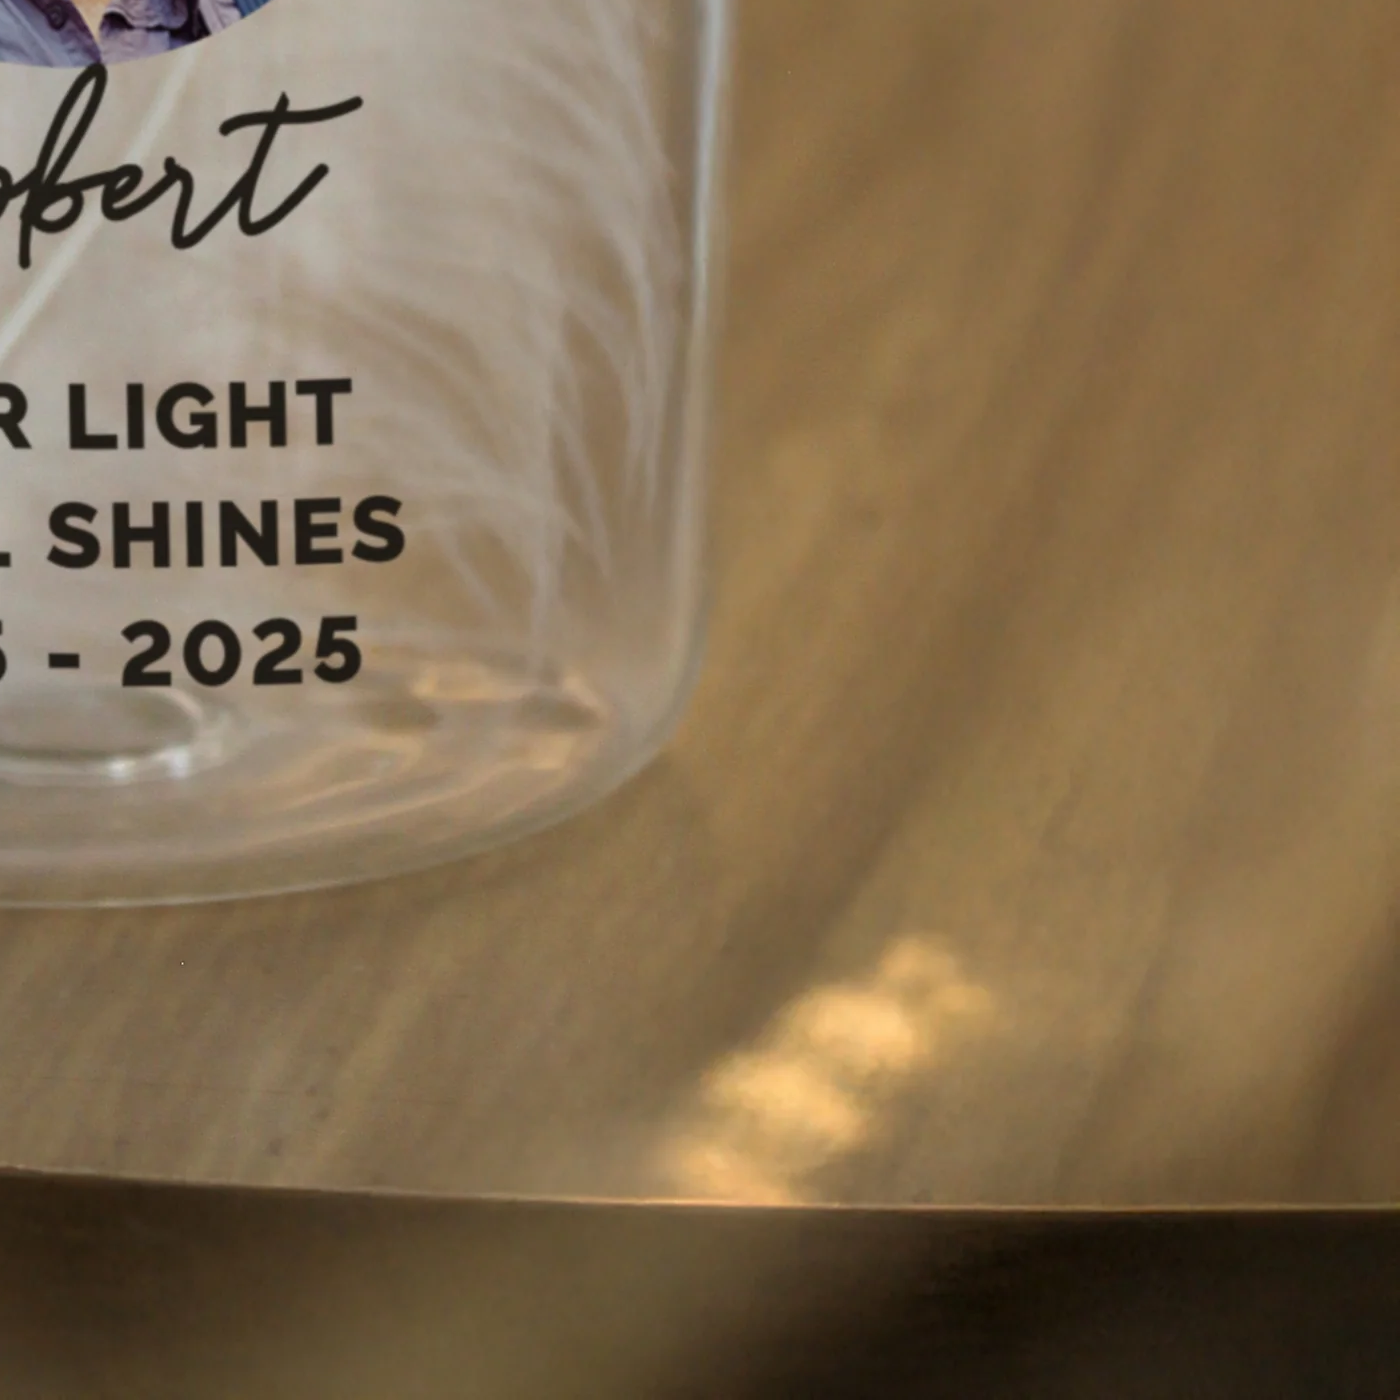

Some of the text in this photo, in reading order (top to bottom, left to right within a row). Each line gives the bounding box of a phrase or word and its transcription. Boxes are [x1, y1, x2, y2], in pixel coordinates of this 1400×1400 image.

[67, 378, 354, 450] LIGHT
[46, 494, 406, 569] SHINES
[48, 652, 81, 669] -
[120, 615, 363, 687] 2025
